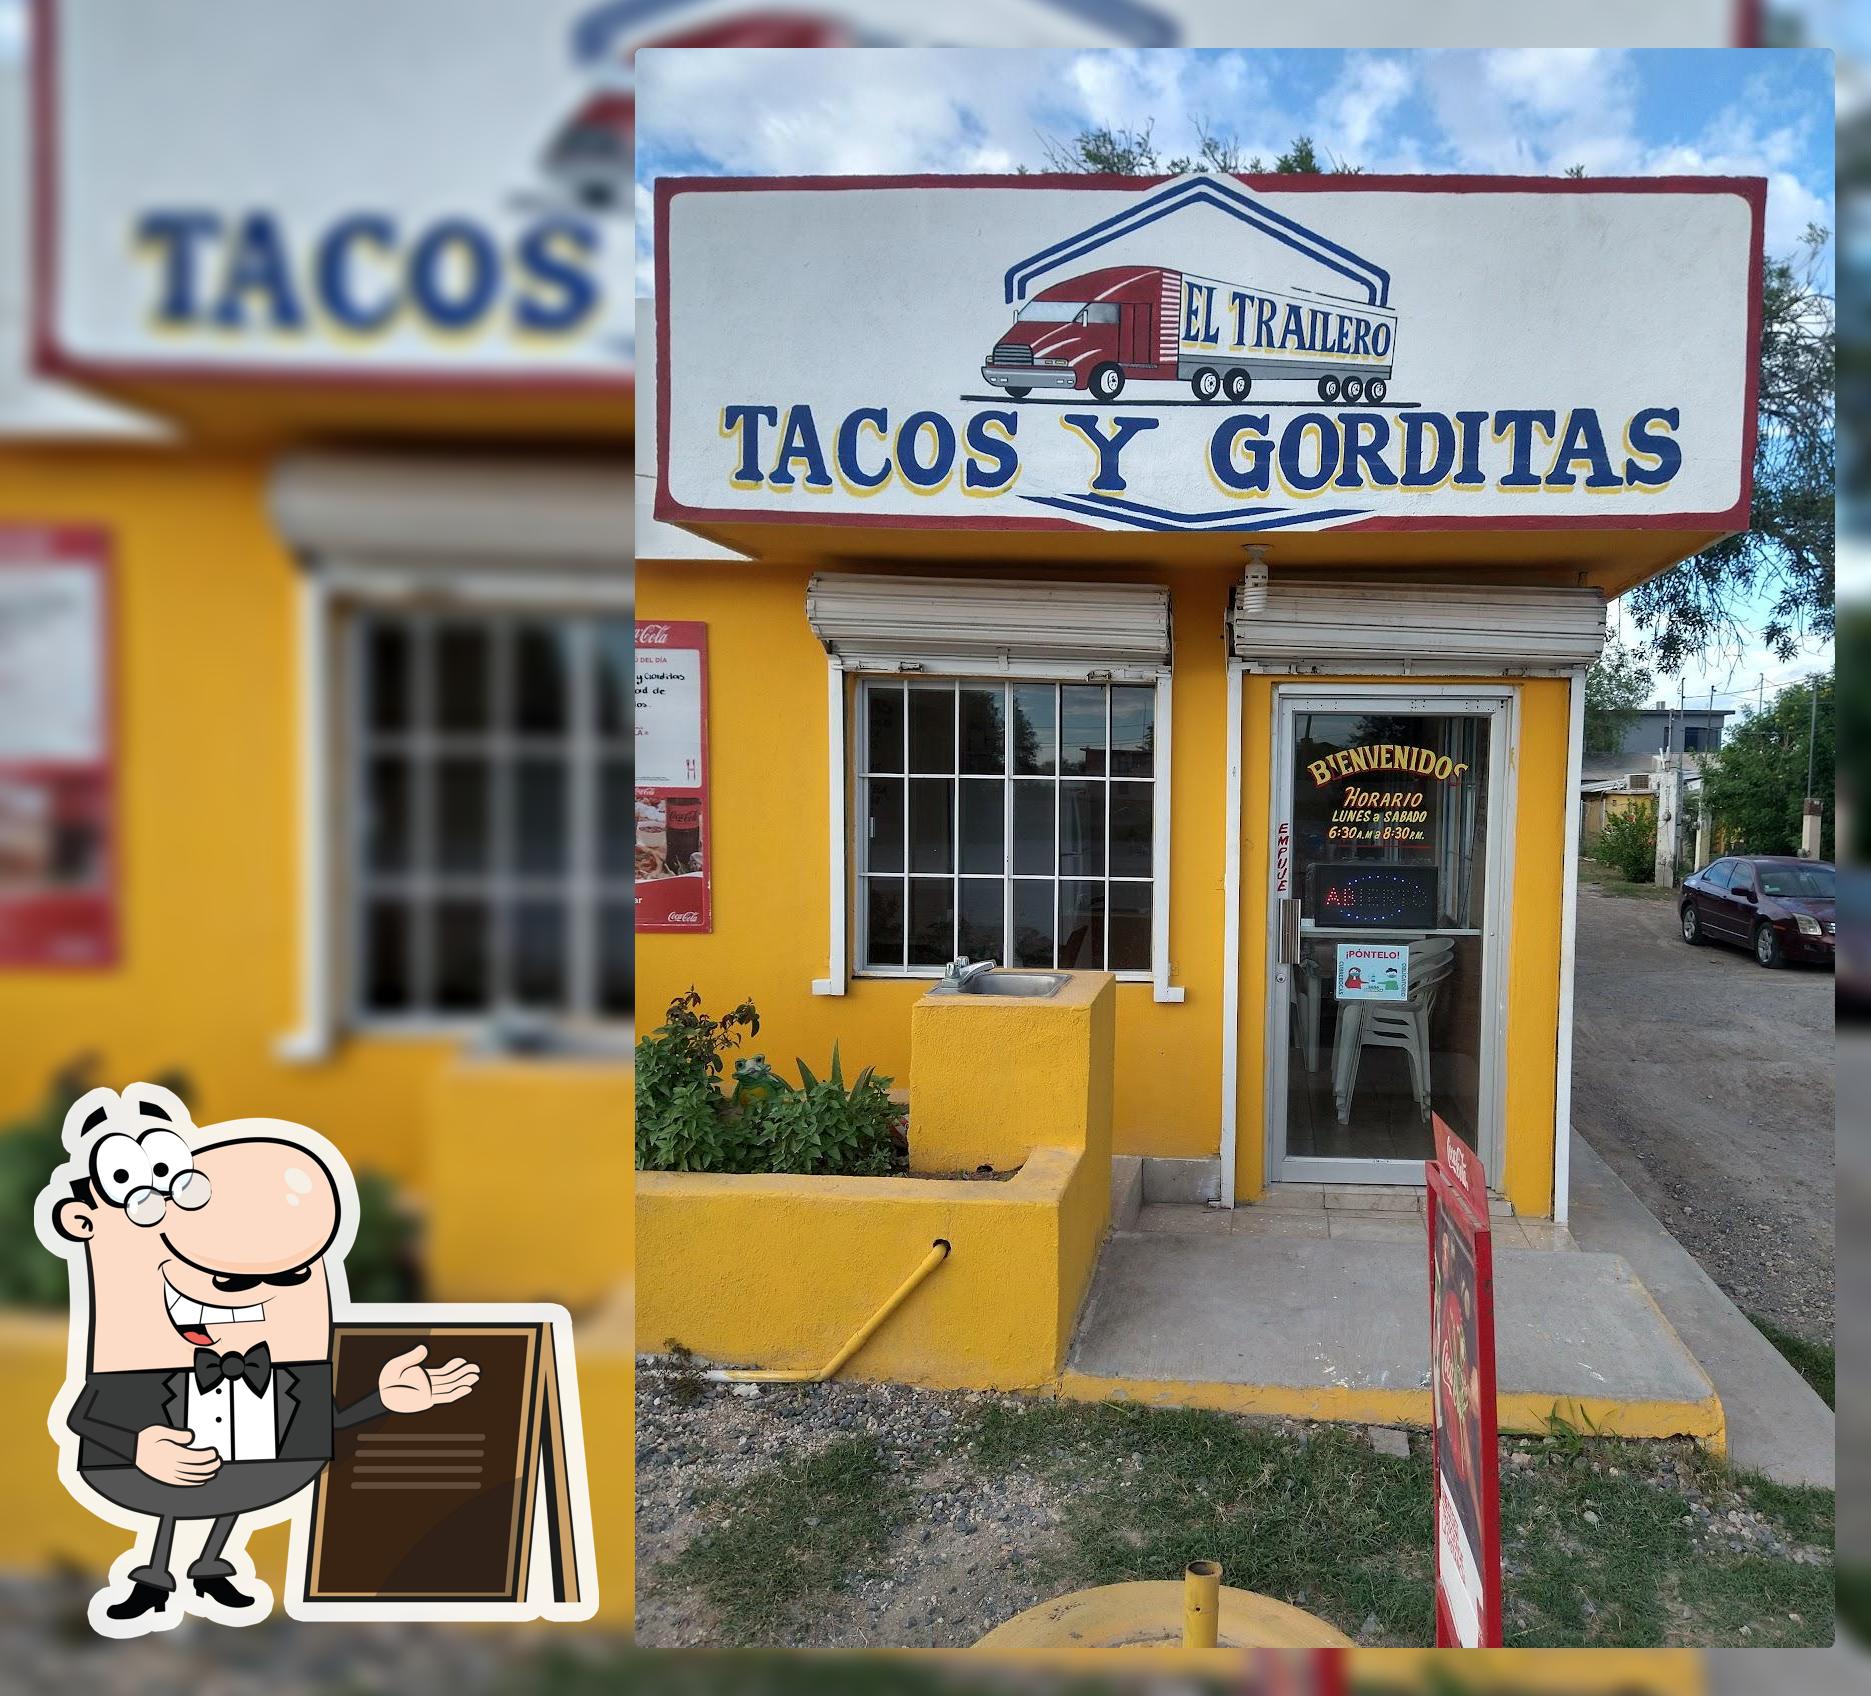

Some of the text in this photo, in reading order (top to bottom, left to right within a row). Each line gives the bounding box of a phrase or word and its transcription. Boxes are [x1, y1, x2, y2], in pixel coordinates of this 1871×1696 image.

[1182, 279, 1391, 359] EL TRAILERO
[721, 403, 1682, 498] TACOS Y GORDITAS
[1331, 810, 1428, 822] LUNES a SABADO
[1277, 823, 1289, 891] EMPUJE
[1346, 948, 1400, 960] ¡PÓNTELO!
